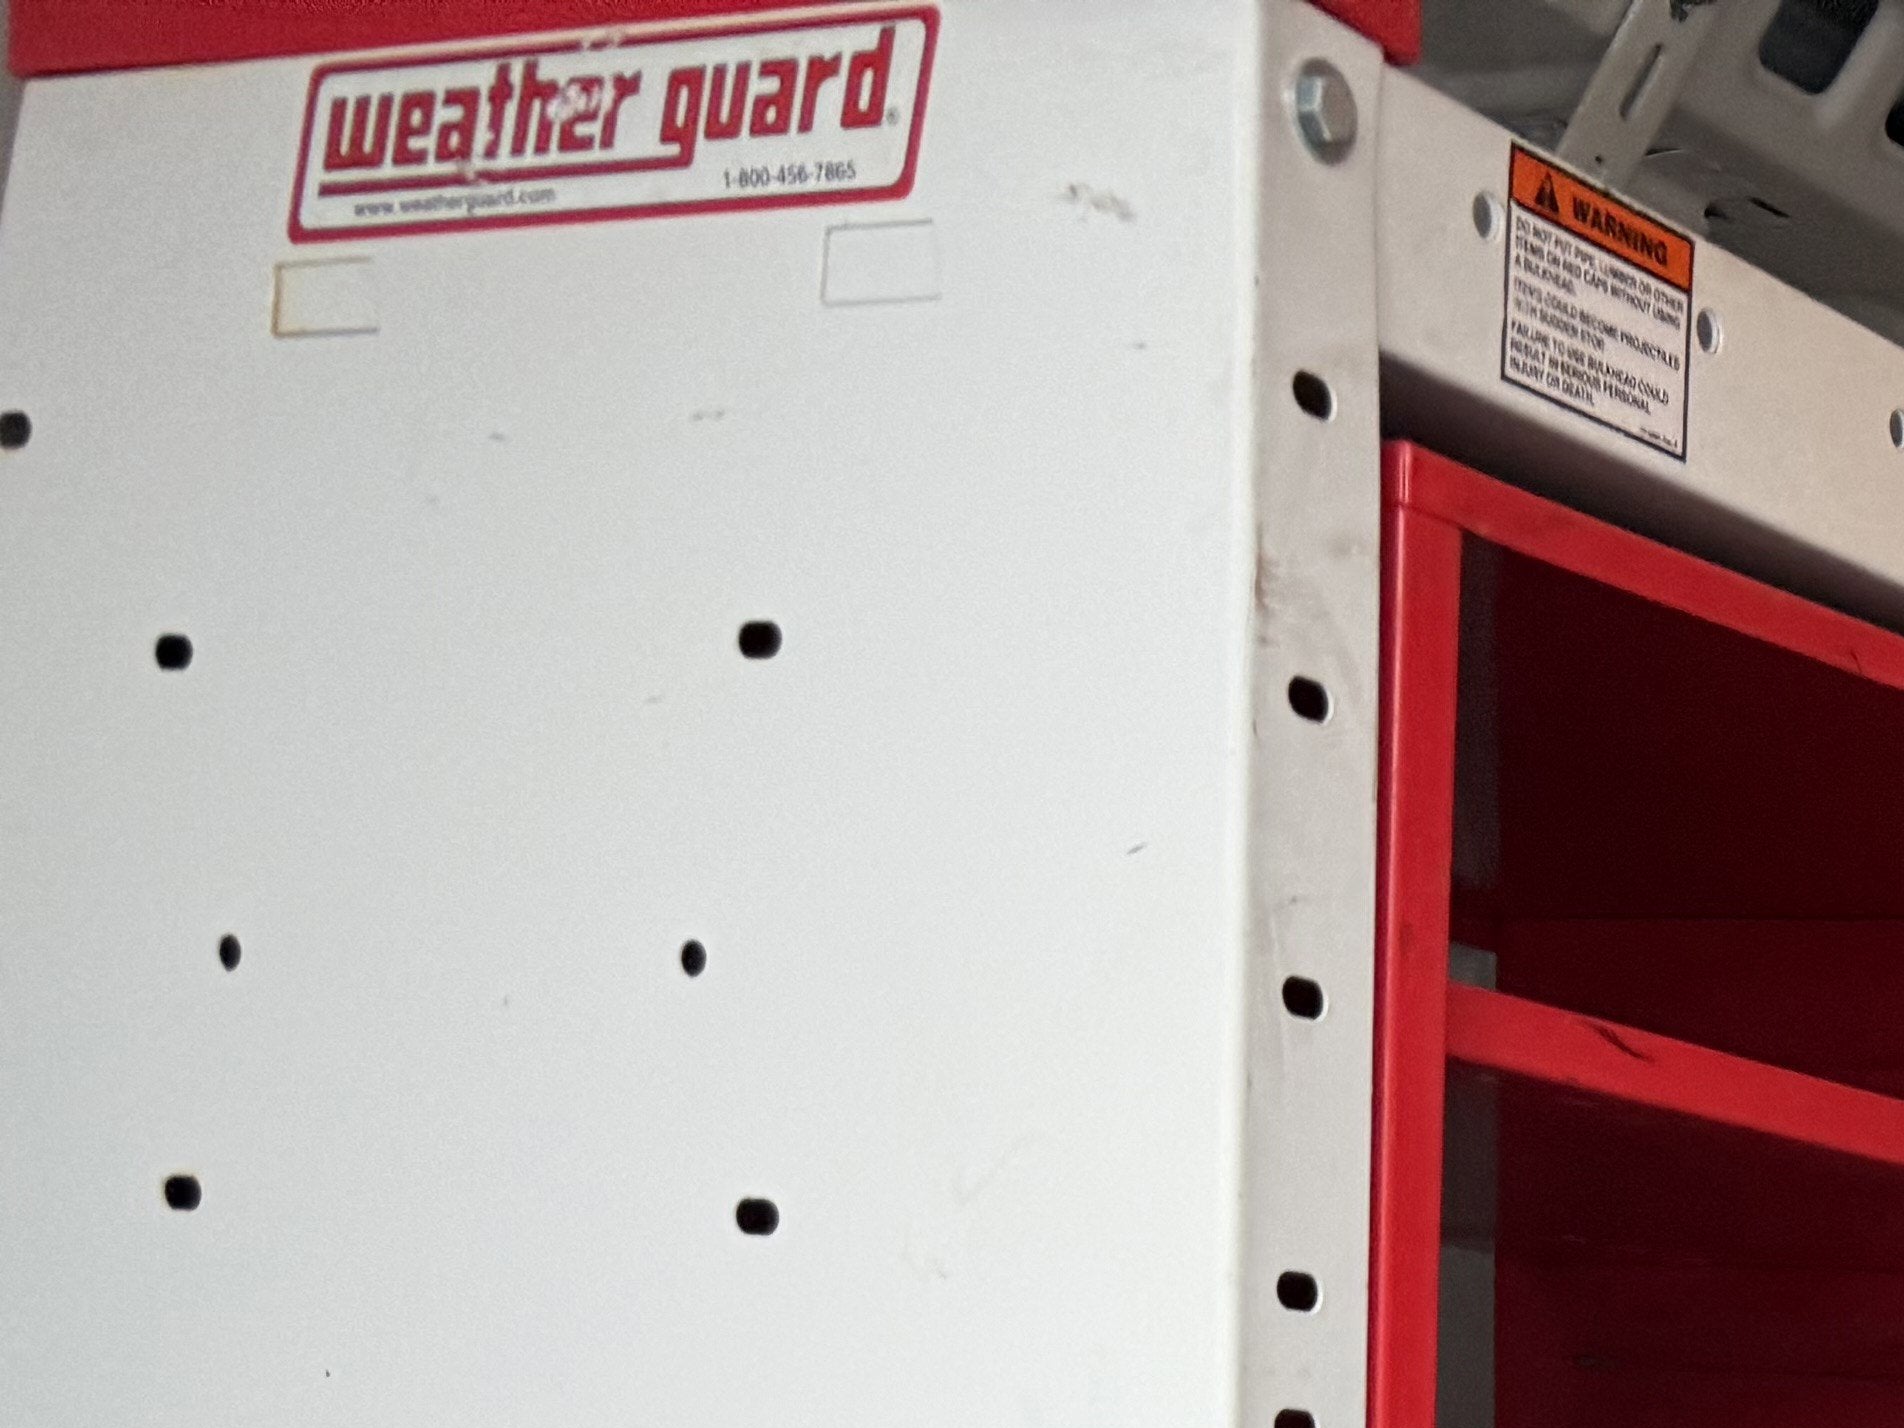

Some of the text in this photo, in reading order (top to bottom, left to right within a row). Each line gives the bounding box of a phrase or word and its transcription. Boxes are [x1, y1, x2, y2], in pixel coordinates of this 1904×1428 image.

[323, 25, 898, 172] weather guard
[1571, 193, 1668, 268] WARNING
